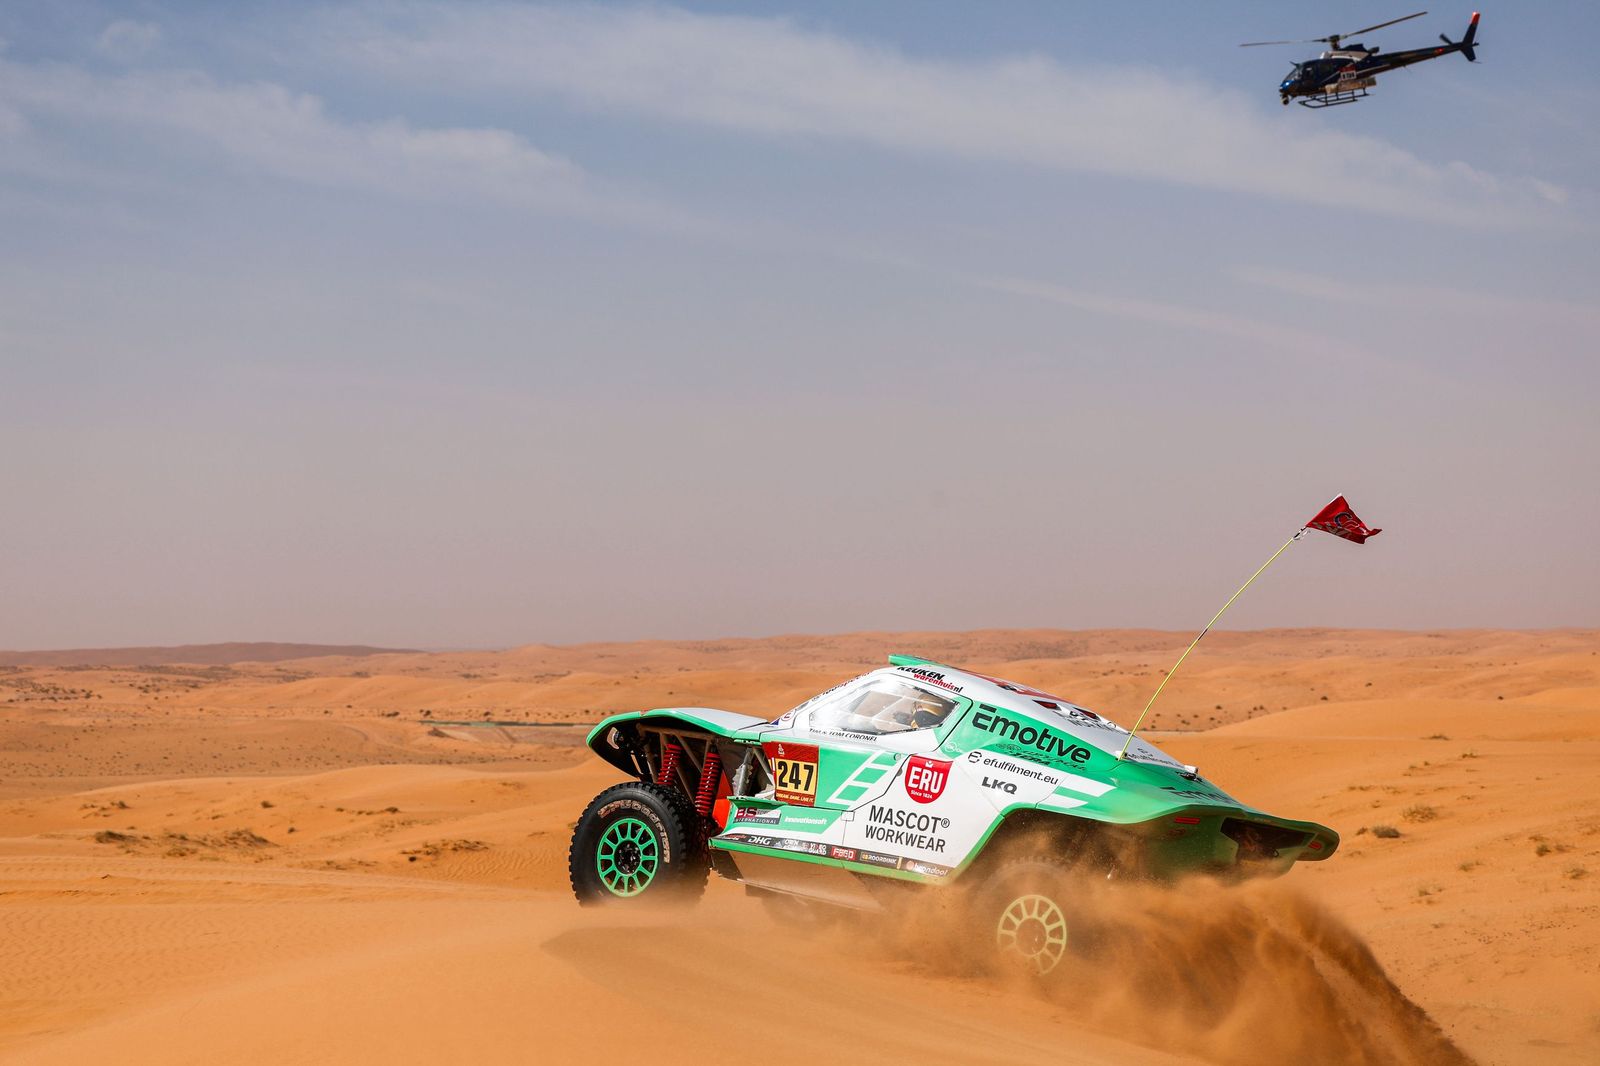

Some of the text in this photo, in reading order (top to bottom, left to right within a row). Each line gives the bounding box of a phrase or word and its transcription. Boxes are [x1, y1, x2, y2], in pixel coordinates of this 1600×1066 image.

[971, 703, 1091, 764] Emotive
[777, 760, 815, 791] 247
[908, 765, 944, 794] ERU
[982, 777, 1018, 795] LKQ
[983, 758, 1059, 786] efulfilment.eu
[747, 835, 772, 845] DHG
[865, 825, 946, 853] WORKWEAR
